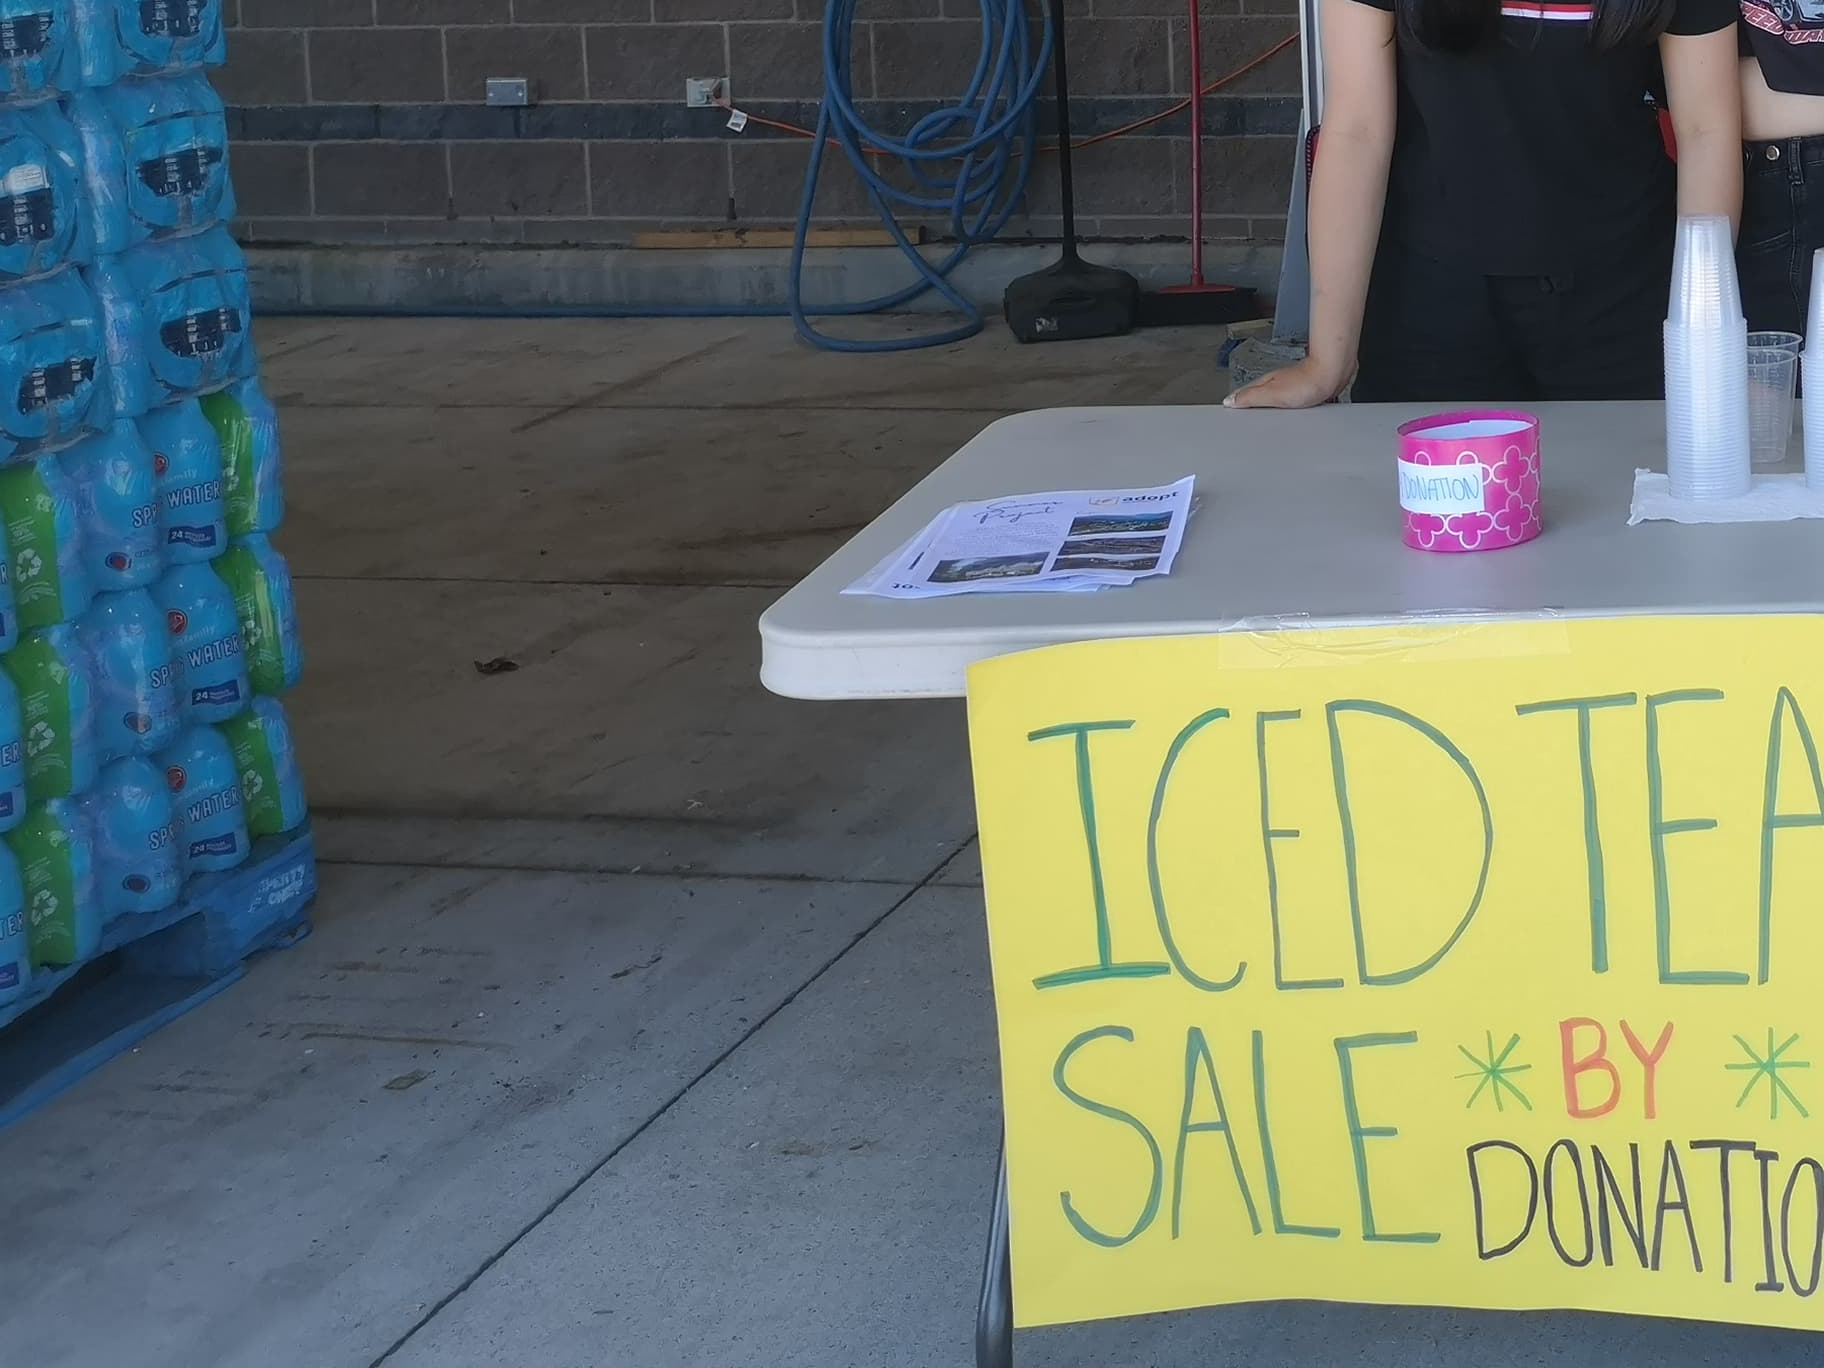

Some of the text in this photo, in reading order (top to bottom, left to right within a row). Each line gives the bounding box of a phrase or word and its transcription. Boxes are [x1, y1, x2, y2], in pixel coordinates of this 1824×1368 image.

[167, 479, 223, 510] WATER
[1122, 490, 1180, 503] adopt
[1401, 472, 1480, 501] DONATION
[187, 632, 241, 668] WATER
[188, 784, 240, 823] WATER
[1027, 699, 1495, 993] ICED
[1051, 1016, 1675, 1248] SALE BY
